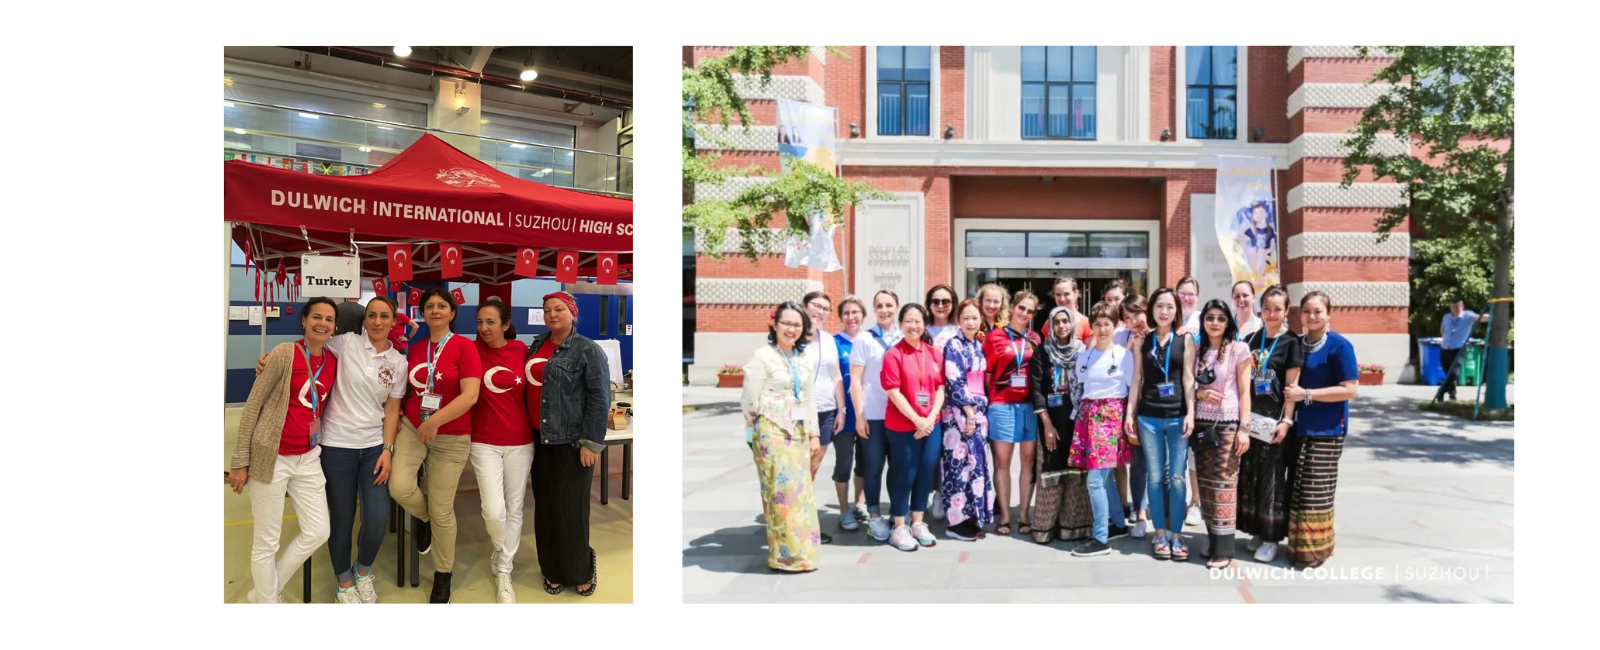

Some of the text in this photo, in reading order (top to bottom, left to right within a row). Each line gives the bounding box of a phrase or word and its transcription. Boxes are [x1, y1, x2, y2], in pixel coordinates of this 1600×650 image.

[271, 189, 366, 215] DULWICH
[373, 200, 504, 226] INTERNATIONAL
[579, 219, 613, 235] HIGH
[305, 275, 353, 289] Turkey
